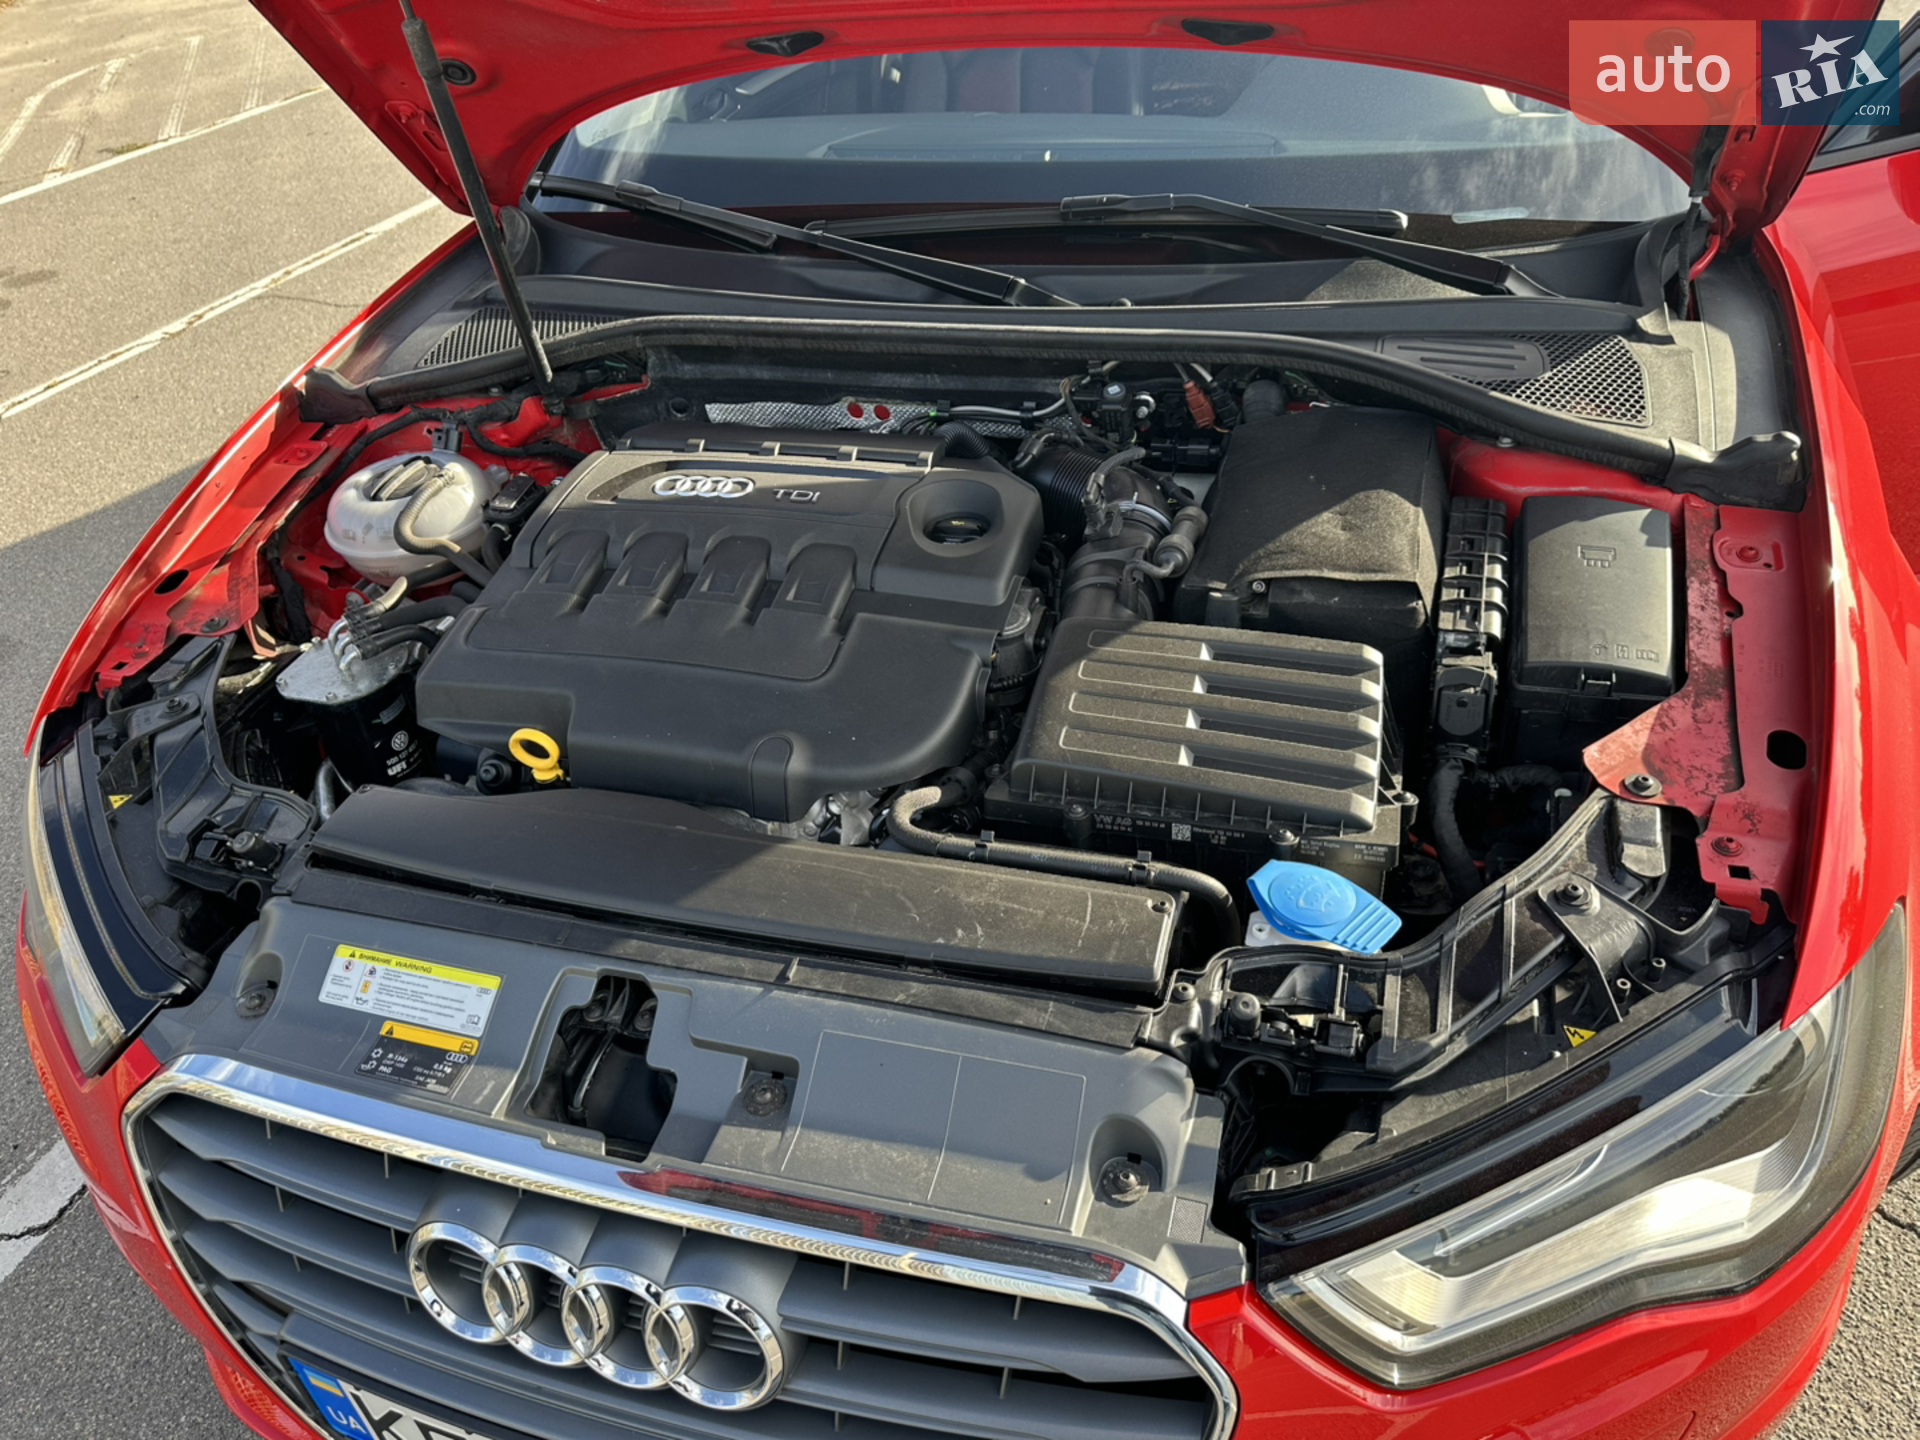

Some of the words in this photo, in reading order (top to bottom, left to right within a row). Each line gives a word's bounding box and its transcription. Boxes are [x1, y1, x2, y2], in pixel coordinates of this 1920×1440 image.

[773, 489, 821, 502] TDI
[358, 953, 392, 966] ВНИМАНИЕ
[395, 960, 432, 974] WARNING
[326, 1406, 367, 1434] UA
